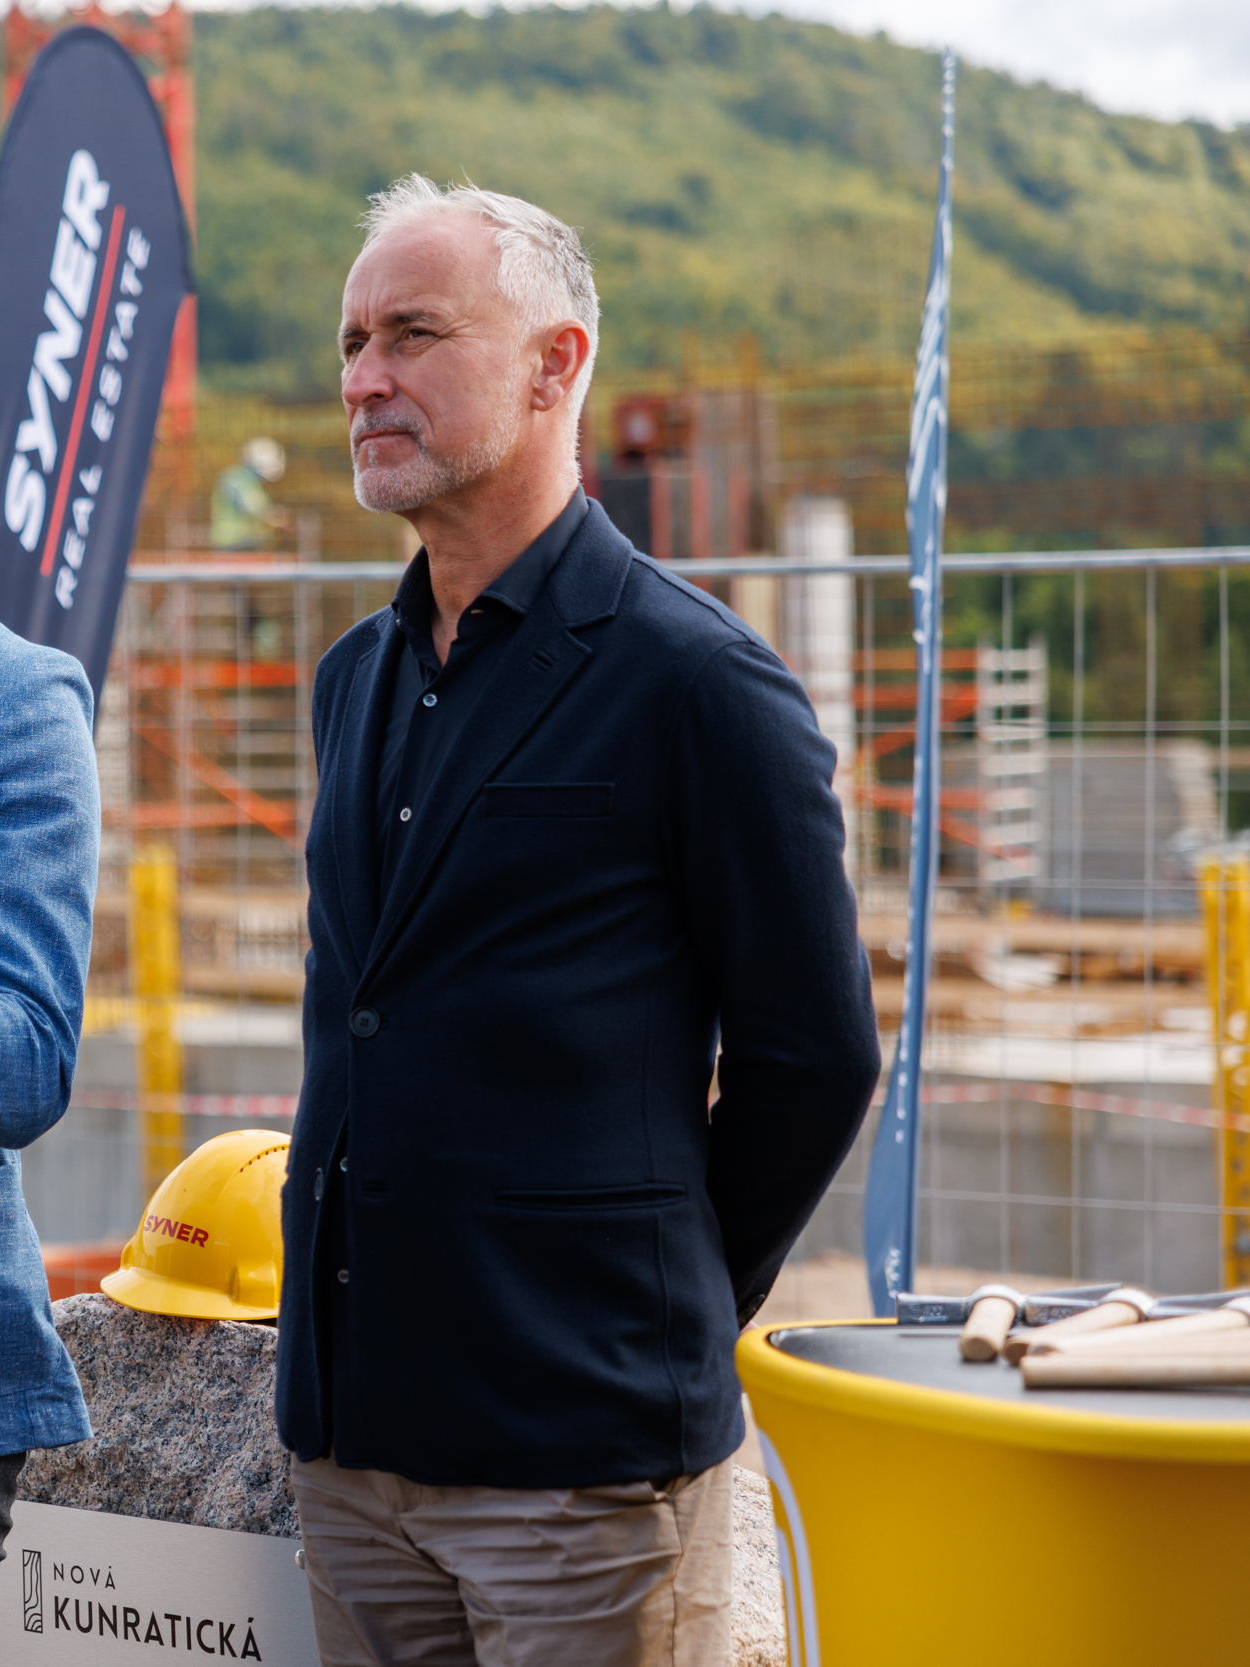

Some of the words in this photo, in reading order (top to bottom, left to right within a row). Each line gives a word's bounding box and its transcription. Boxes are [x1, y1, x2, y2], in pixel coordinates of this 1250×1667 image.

[5, 149, 109, 552] SYNER
[55, 464, 103, 610] REAL
[90, 227, 151, 442] ESTATE
[143, 1214, 209, 1248] SYNER
[53, 1562, 116, 1590] NOVÁ
[54, 1595, 262, 1662] KUNRATICKÁ
